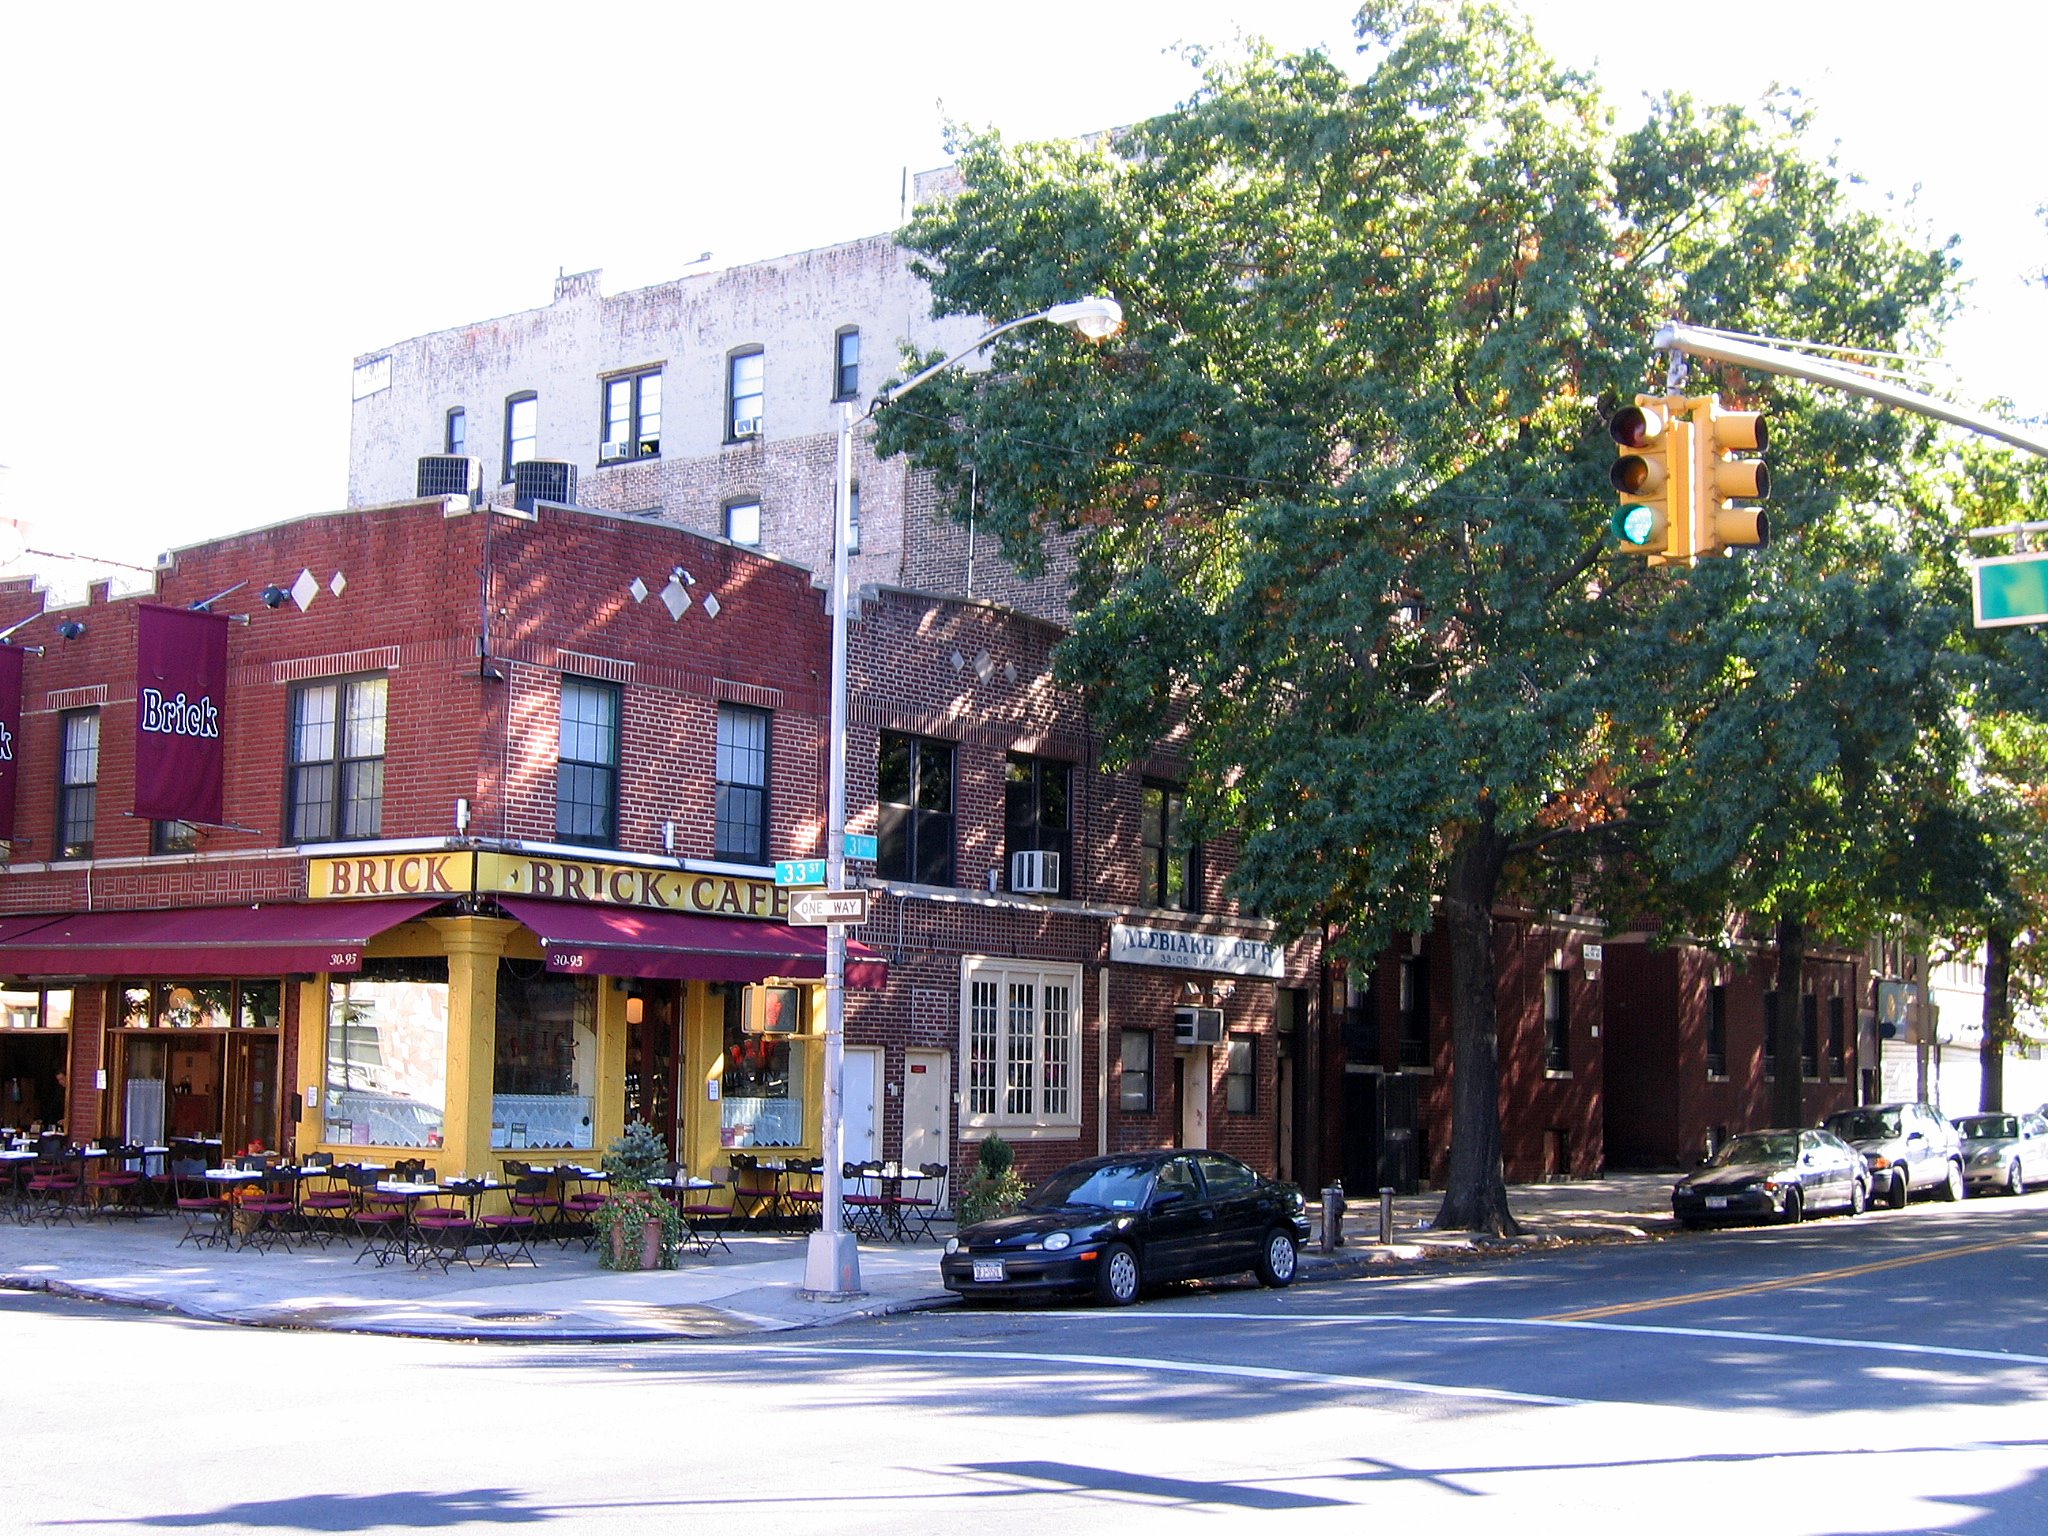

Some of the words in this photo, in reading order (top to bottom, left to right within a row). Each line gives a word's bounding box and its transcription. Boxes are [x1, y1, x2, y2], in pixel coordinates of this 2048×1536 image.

[142, 688, 219, 738] Brick
[849, 837, 860, 855] 31
[330, 855, 453, 895] BRICK
[783, 863, 806, 882] 33
[809, 863, 820, 873] ST
[529, 860, 670, 907] BRICK
[691, 877, 788, 918] CAFE
[801, 902, 823, 914] ONE
[833, 901, 857, 914] WAY
[329, 953, 358, 966] 30-95
[553, 954, 583, 967] 30-95
